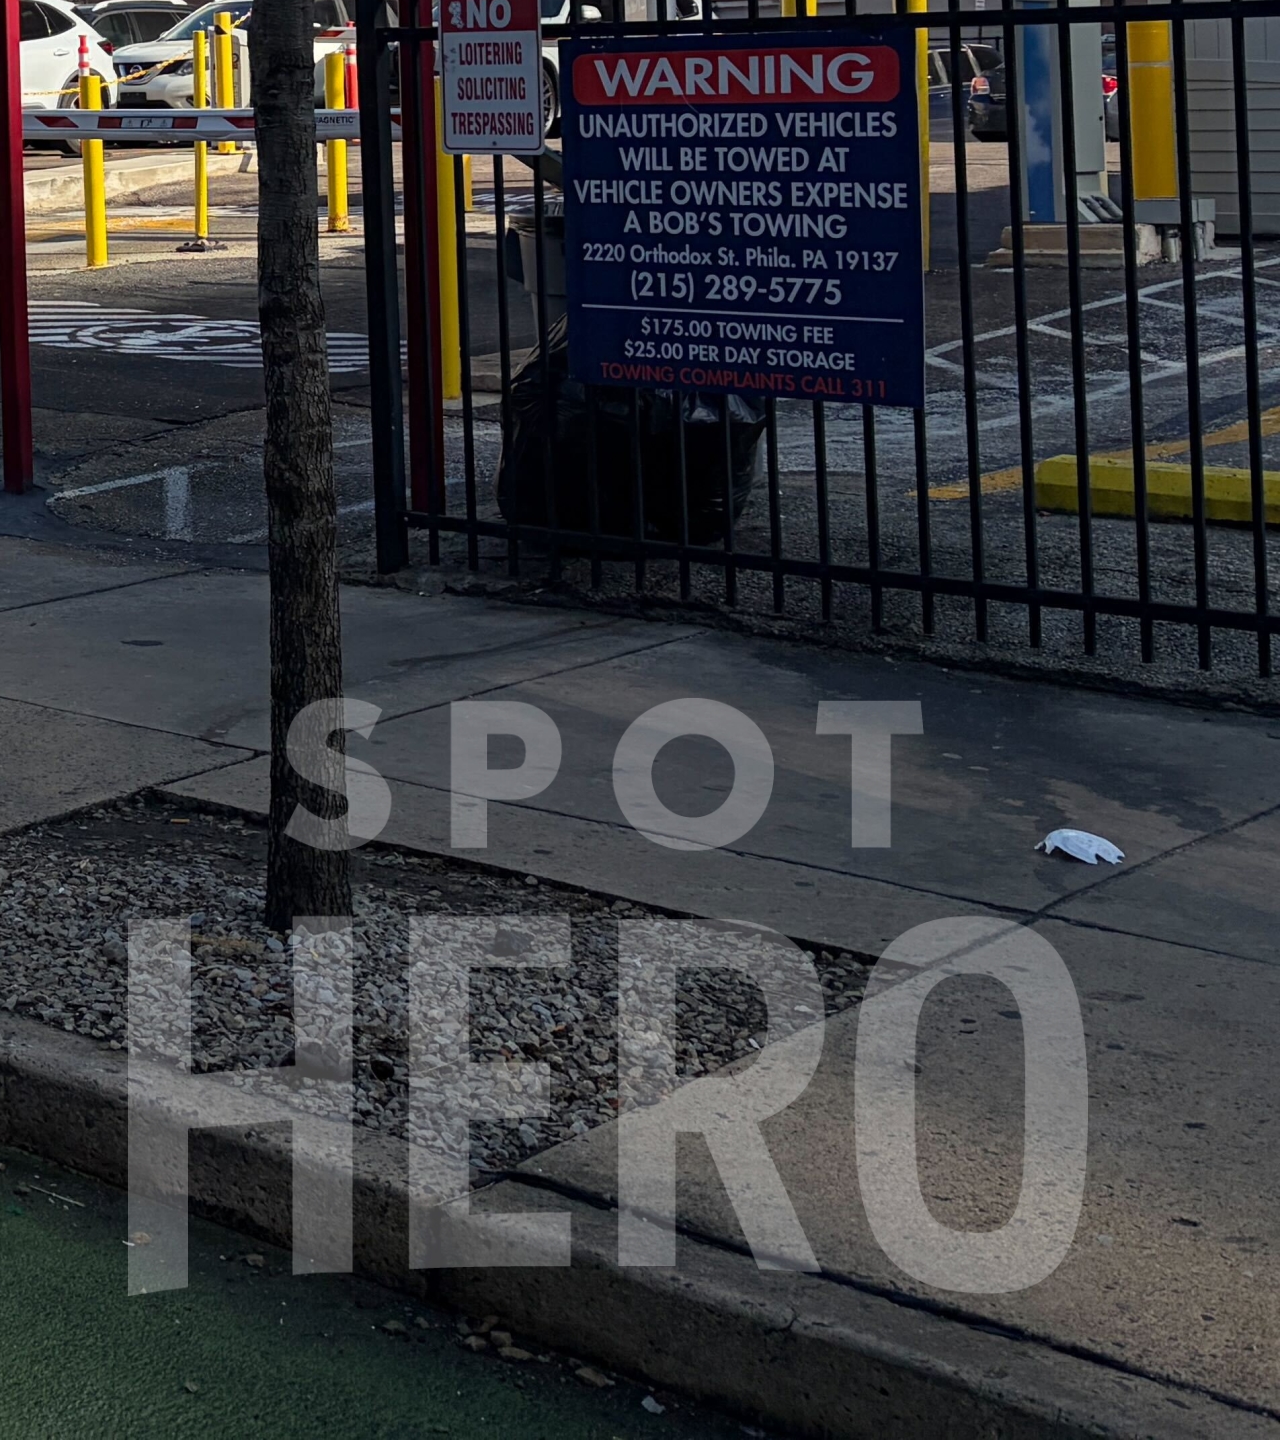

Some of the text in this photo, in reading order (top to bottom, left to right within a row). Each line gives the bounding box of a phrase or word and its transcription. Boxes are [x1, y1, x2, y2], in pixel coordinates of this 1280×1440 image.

[458, 41, 523, 66] LOITERING
[457, 76, 527, 101] SOLICITING
[593, 52, 875, 97] WARNING
[451, 112, 534, 136] TRESPASSING
[578, 111, 898, 139] UNAUTHORIZED VEHICLES
[618, 146, 850, 173] WILL BE TOWED AT
[573, 179, 908, 209] VEHICLE OWNERS EXPENSE
[623, 210, 848, 239] A BOB'S TOWING
[582, 243, 899, 272] 2220 Orthodox St. Phila. PA 19137
[631, 269, 842, 305] (215) 289-5775
[640, 316, 834, 345] $175.00 TOWING FEE
[624, 339, 856, 371] $25.00 PER DAY STORAGE
[600, 361, 887, 399] TOWING COMPLAINTS CALL 311
